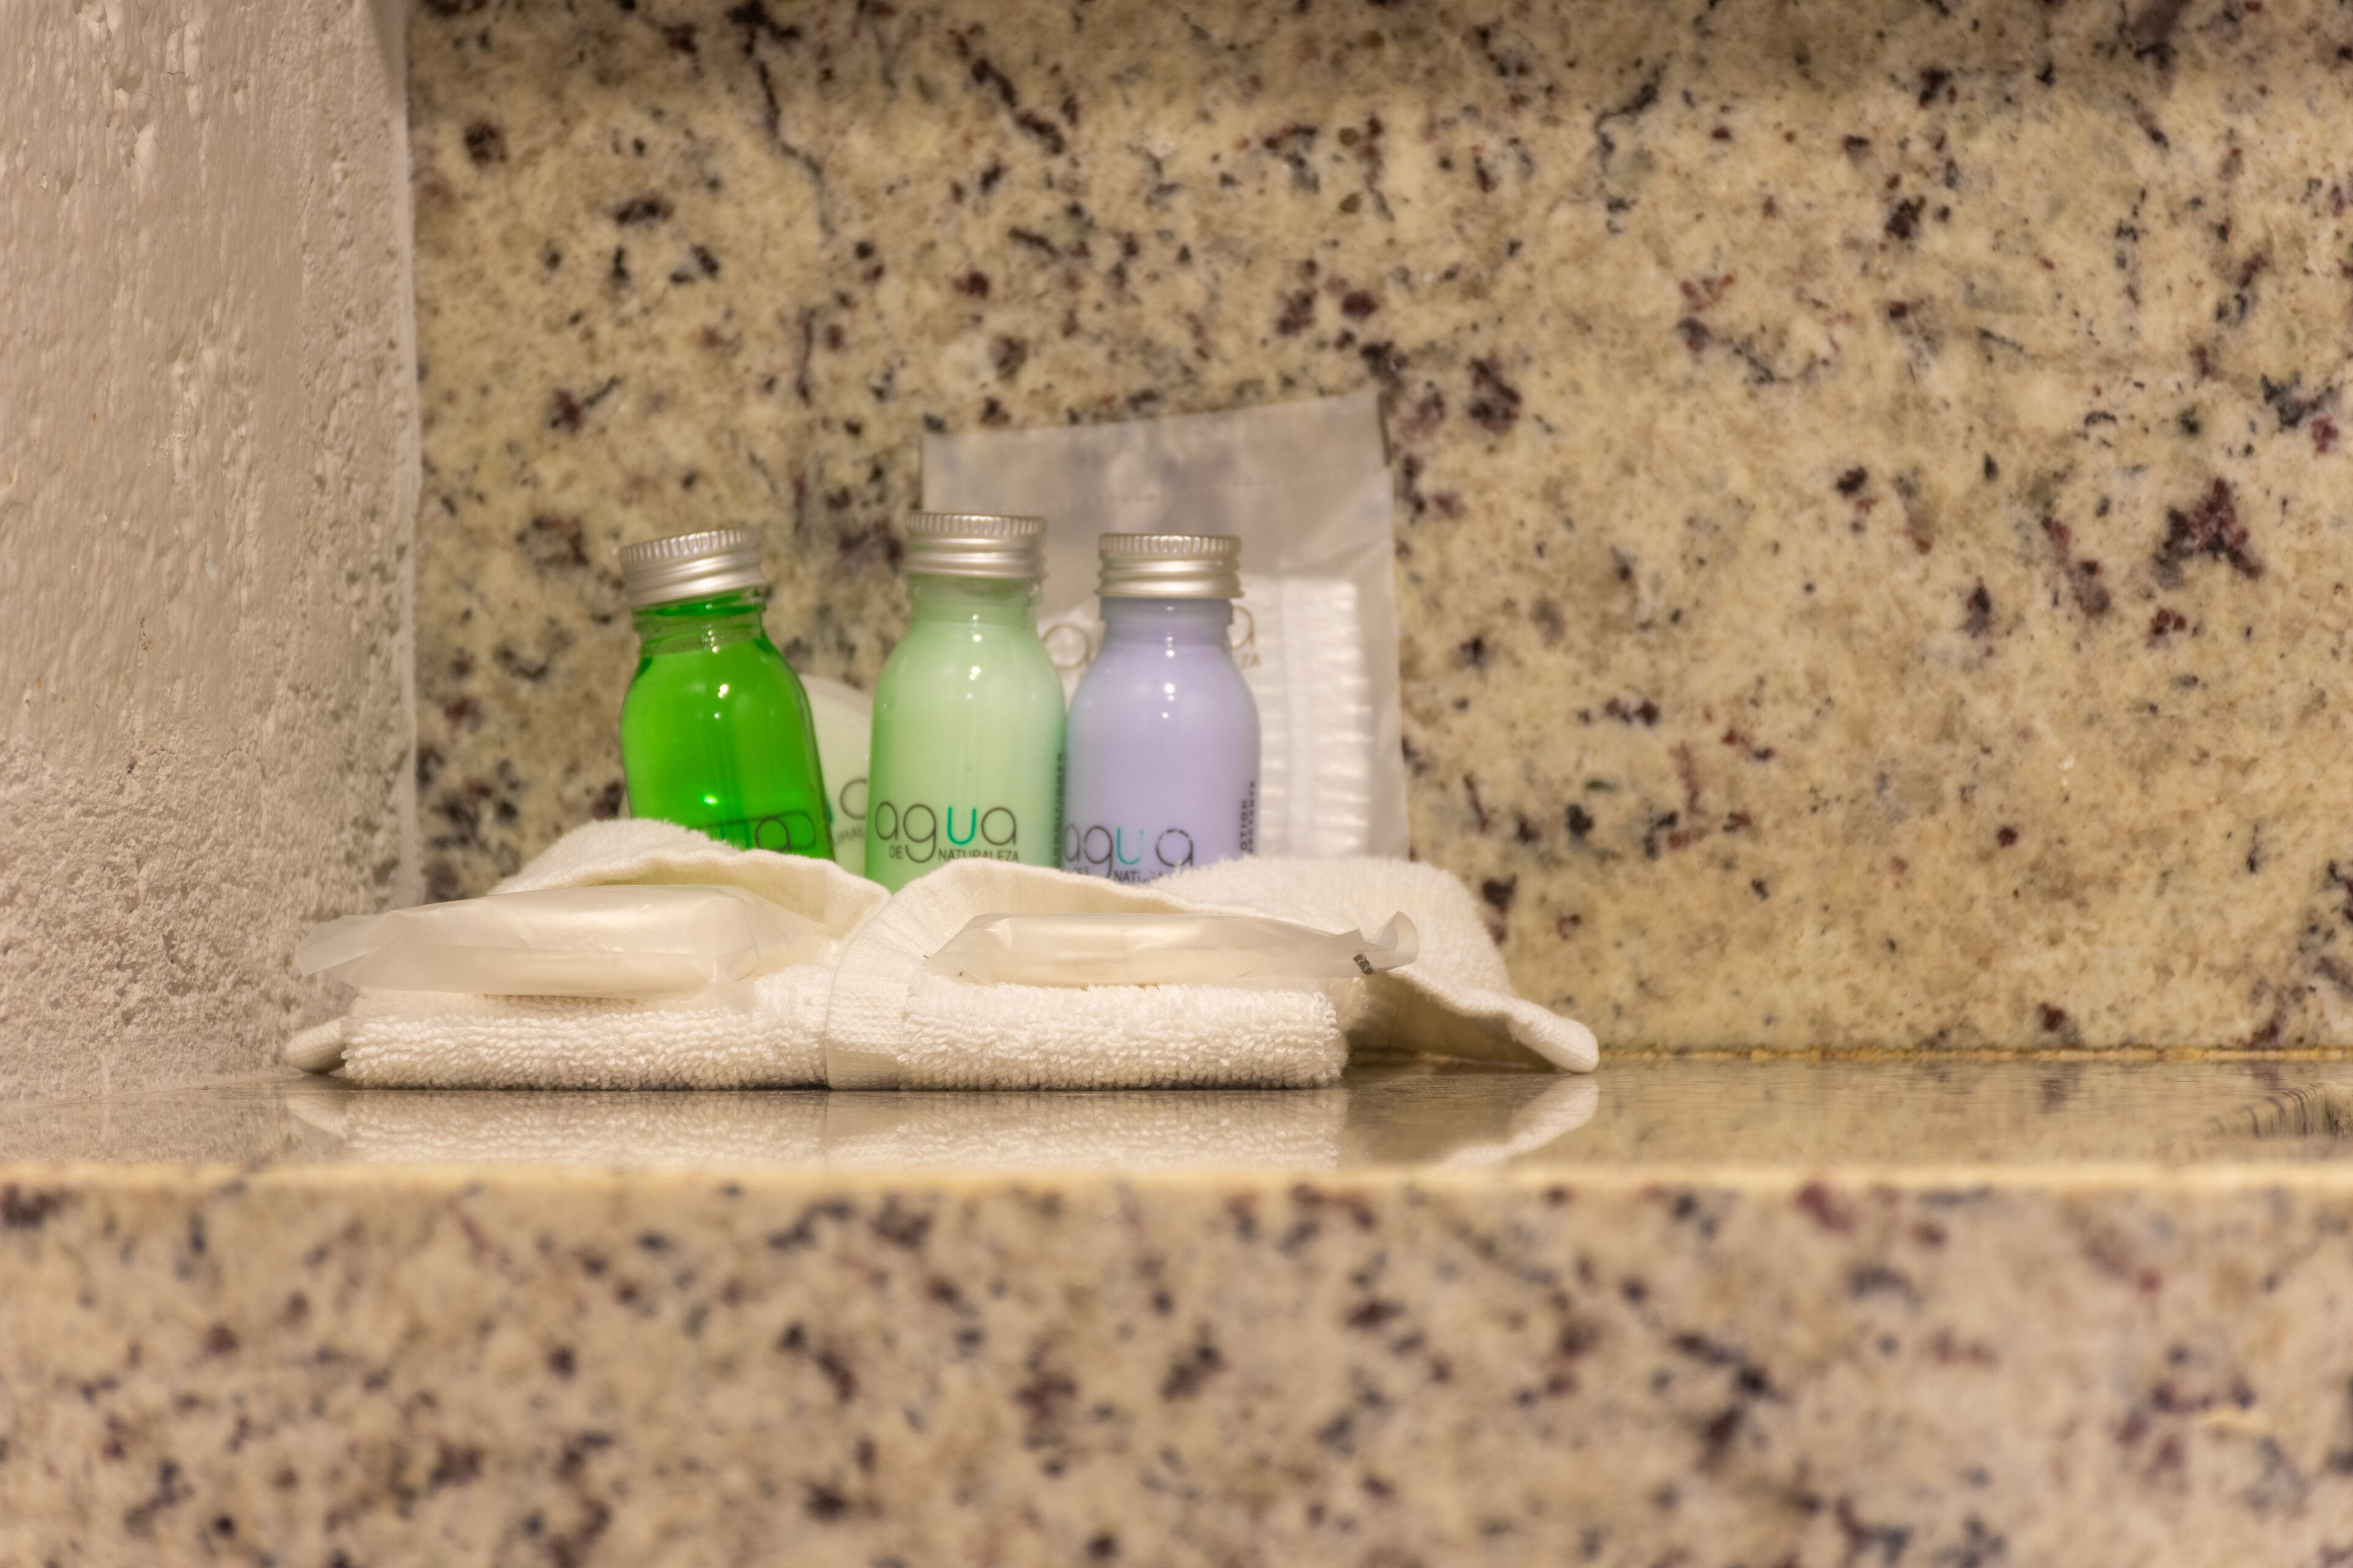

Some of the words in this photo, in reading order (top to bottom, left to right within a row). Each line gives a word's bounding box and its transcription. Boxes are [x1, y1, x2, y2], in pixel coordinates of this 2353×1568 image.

[875, 801, 1017, 863] agua
[889, 846, 902, 859] DE
[1064, 824, 1193, 879] agua
